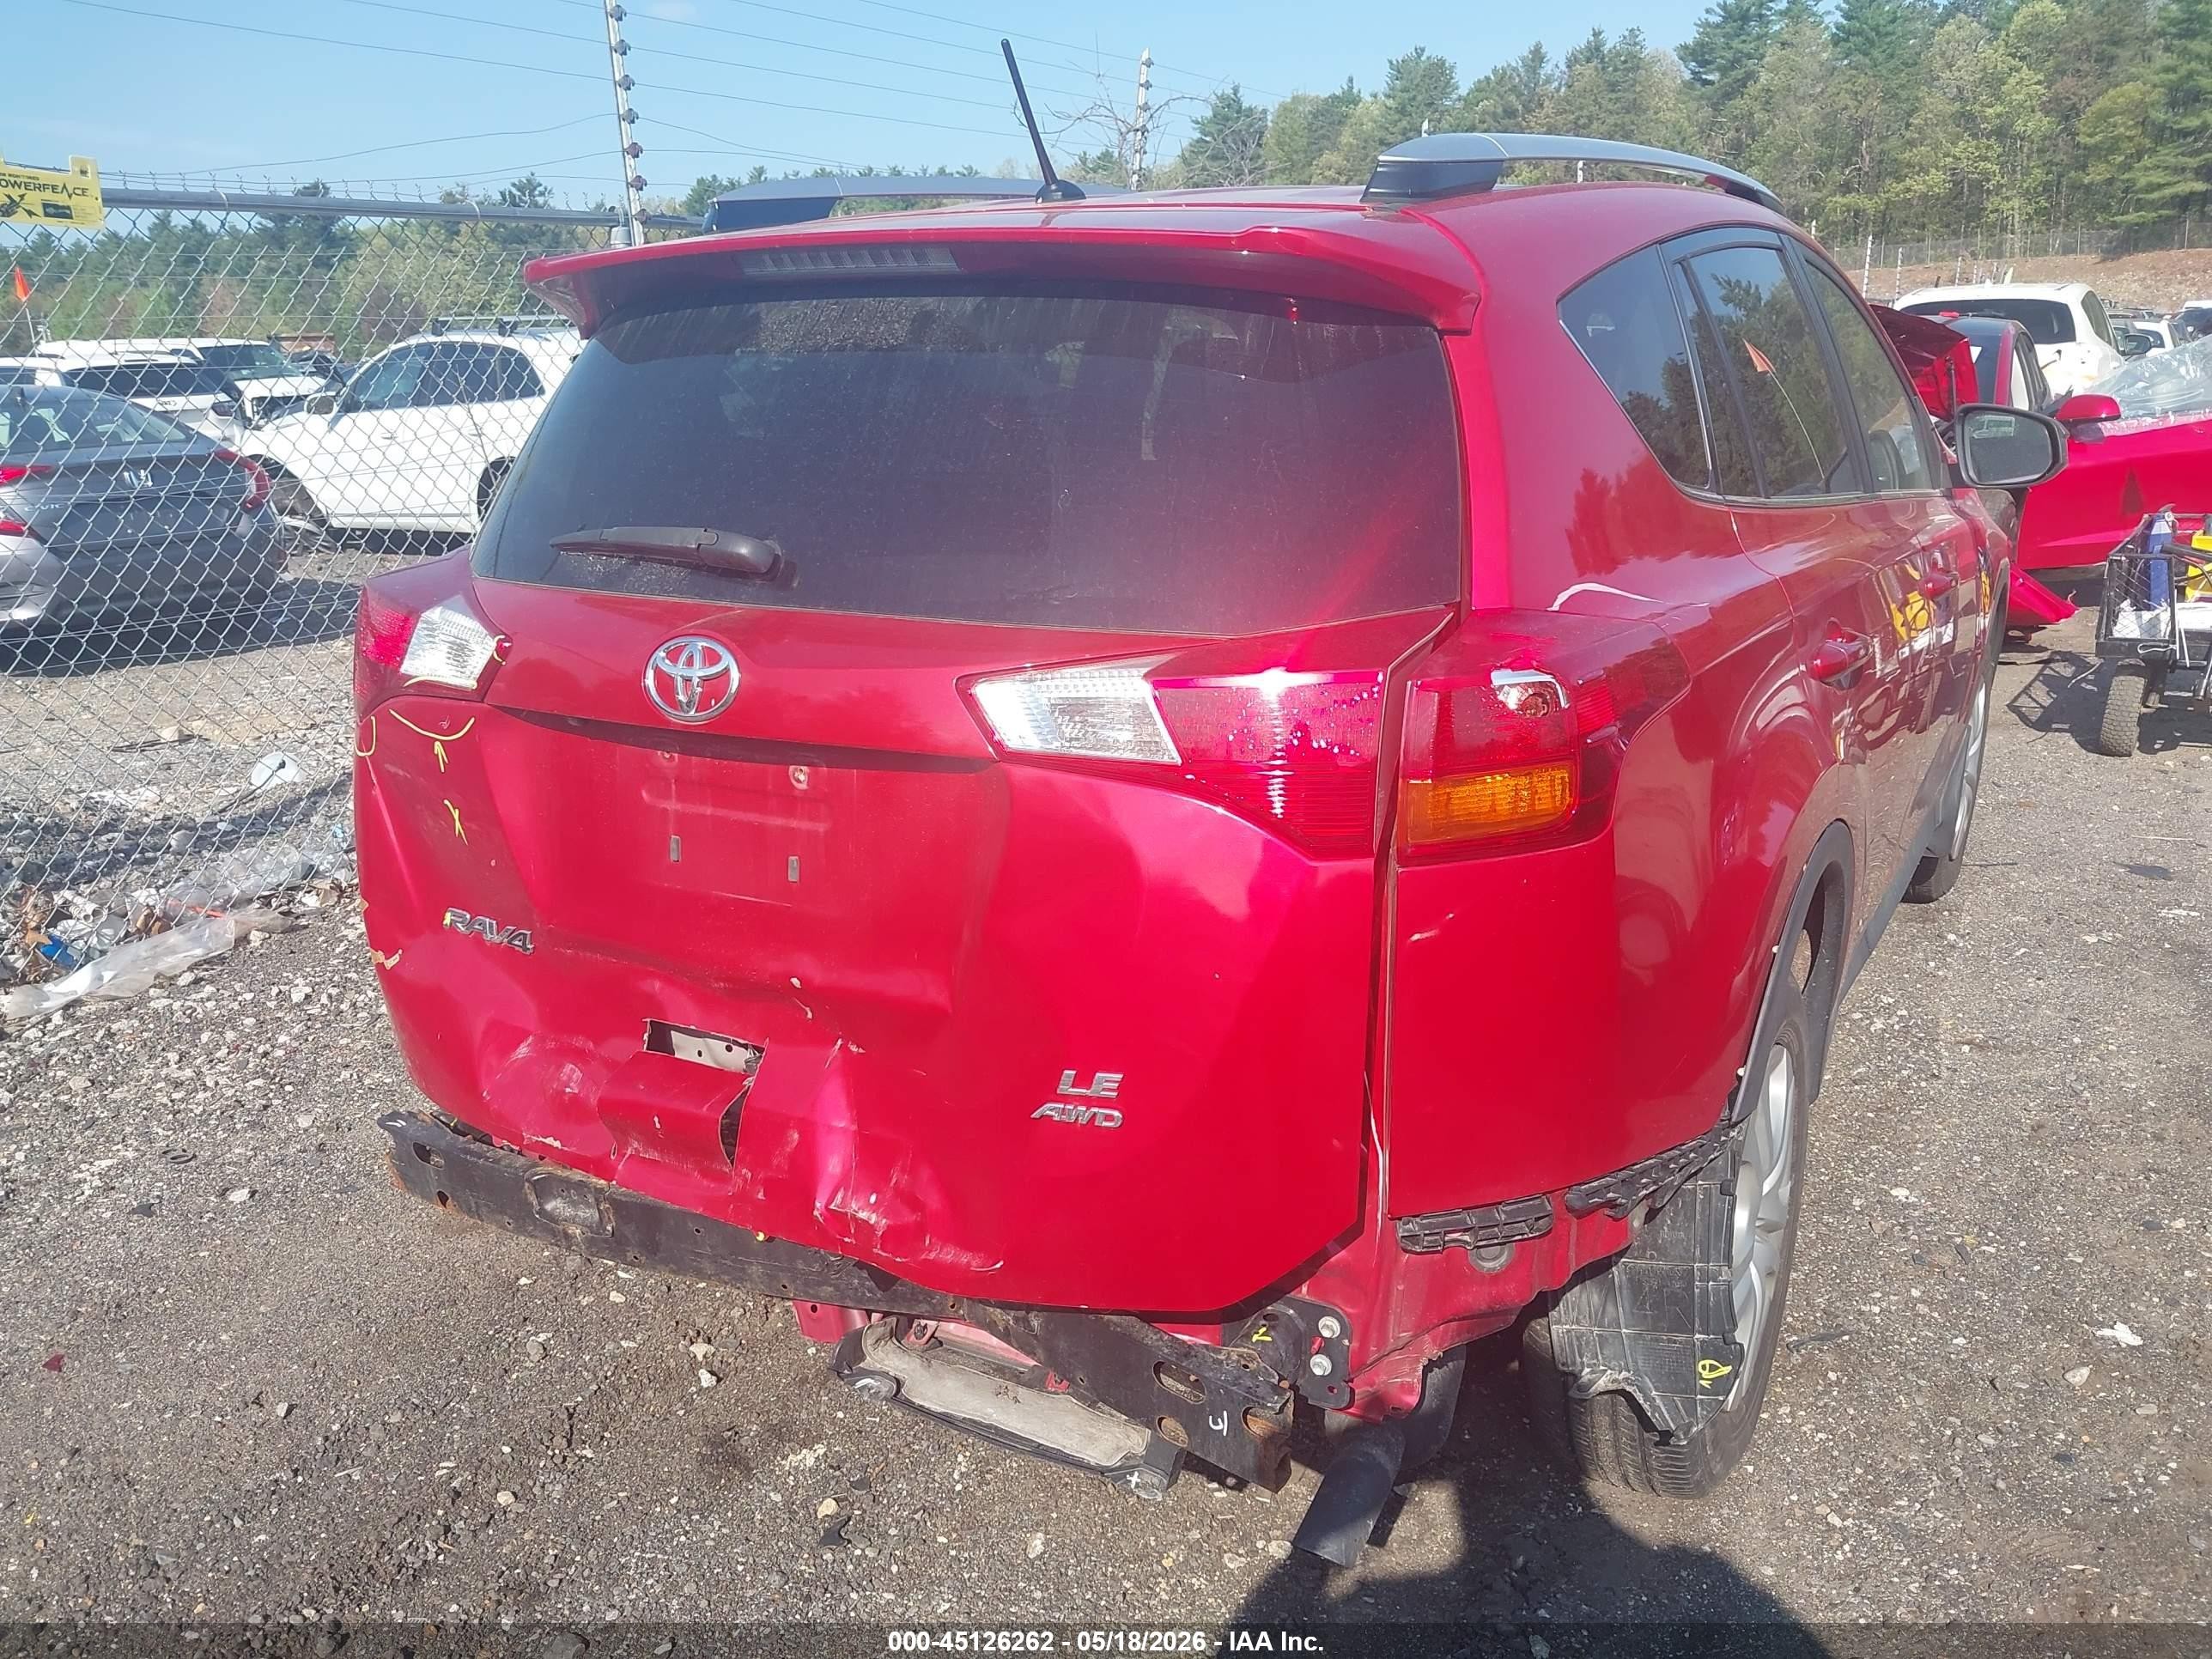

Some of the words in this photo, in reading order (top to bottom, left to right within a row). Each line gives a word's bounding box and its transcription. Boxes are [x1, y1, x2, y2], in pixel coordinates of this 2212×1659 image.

[0, 178, 89, 200] OWERFENCE
[442, 907, 535, 955] RAV4
[1056, 1069, 1124, 1098] LE
[1030, 1102, 1124, 1128] AWD
